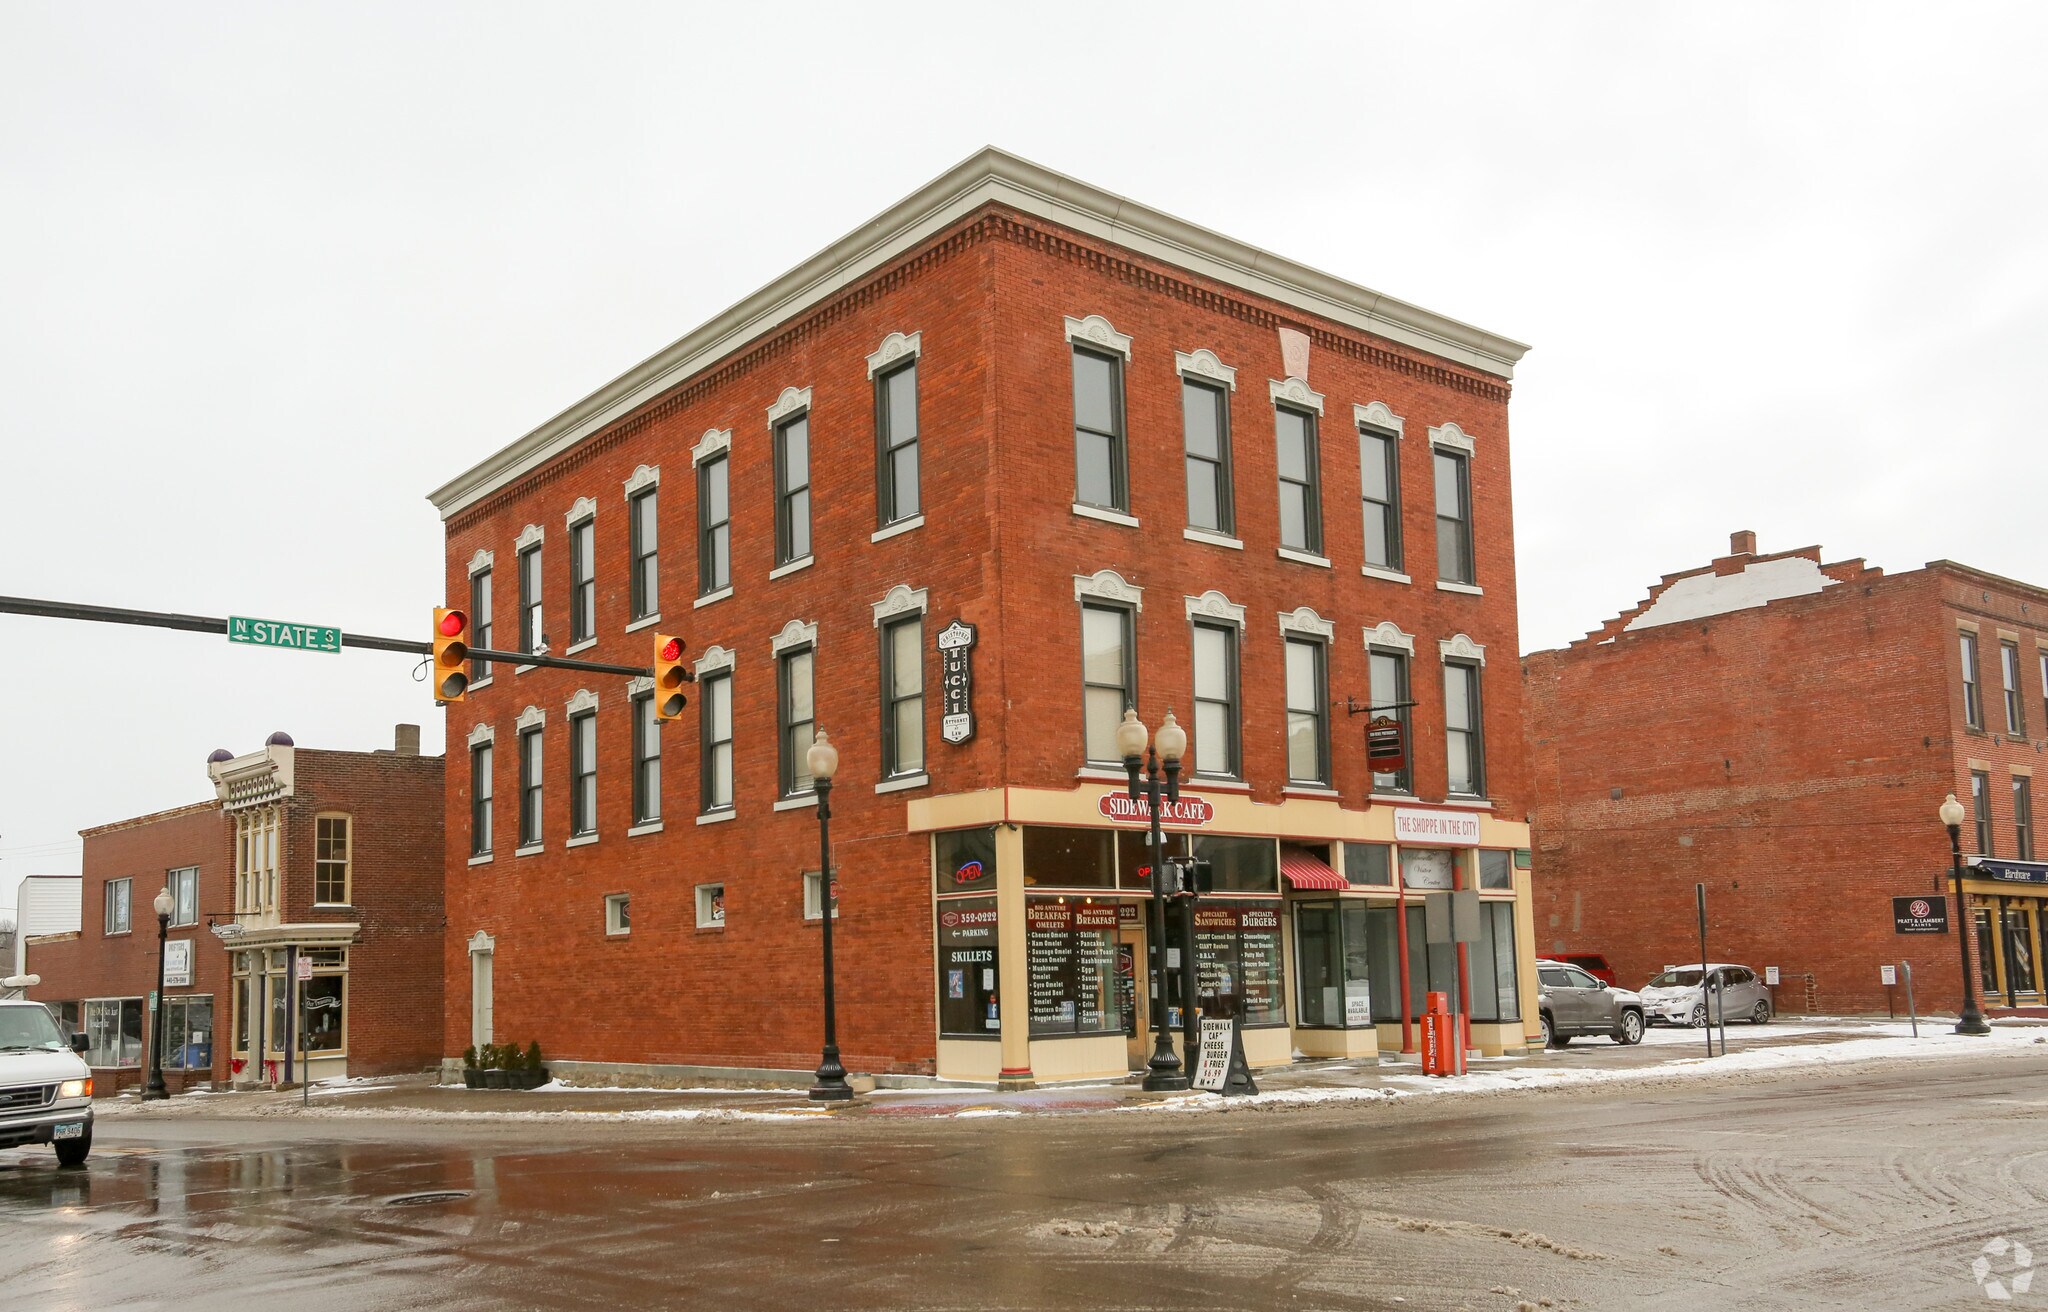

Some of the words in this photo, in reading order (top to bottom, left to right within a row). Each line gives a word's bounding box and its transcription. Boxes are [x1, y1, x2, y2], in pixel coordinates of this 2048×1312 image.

[237, 620, 246, 632] N
[253, 622, 318, 648] STATE
[325, 630, 333, 642] S
[941, 631, 969, 646] CHRISTOPHER
[950, 648, 960, 713] TUCCI
[1175, 802, 1205, 819] CAFE
[1398, 816, 1410, 832] THE
[1413, 818, 1438, 834] SHOPPE
[1440, 820, 1447, 834] IN
[1448, 820, 1460, 835] THE
[1463, 821, 1476, 836] CITY
[956, 865, 981, 884] OPEN
[1424, 876, 1440, 885] Center
[2005, 869, 2031, 880] Hardware
[961, 912, 997, 923] 352-0222
[1028, 909, 1070, 920] BREAKFAST
[1120, 908, 1135, 916] 222
[1077, 914, 1116, 925] BREAKFAST
[1195, 914, 1236, 926] SANDWICHES
[1242, 914, 1276, 926] BURGERS
[962, 929, 988, 937] PARKING
[952, 950, 992, 962] SKILLETS
